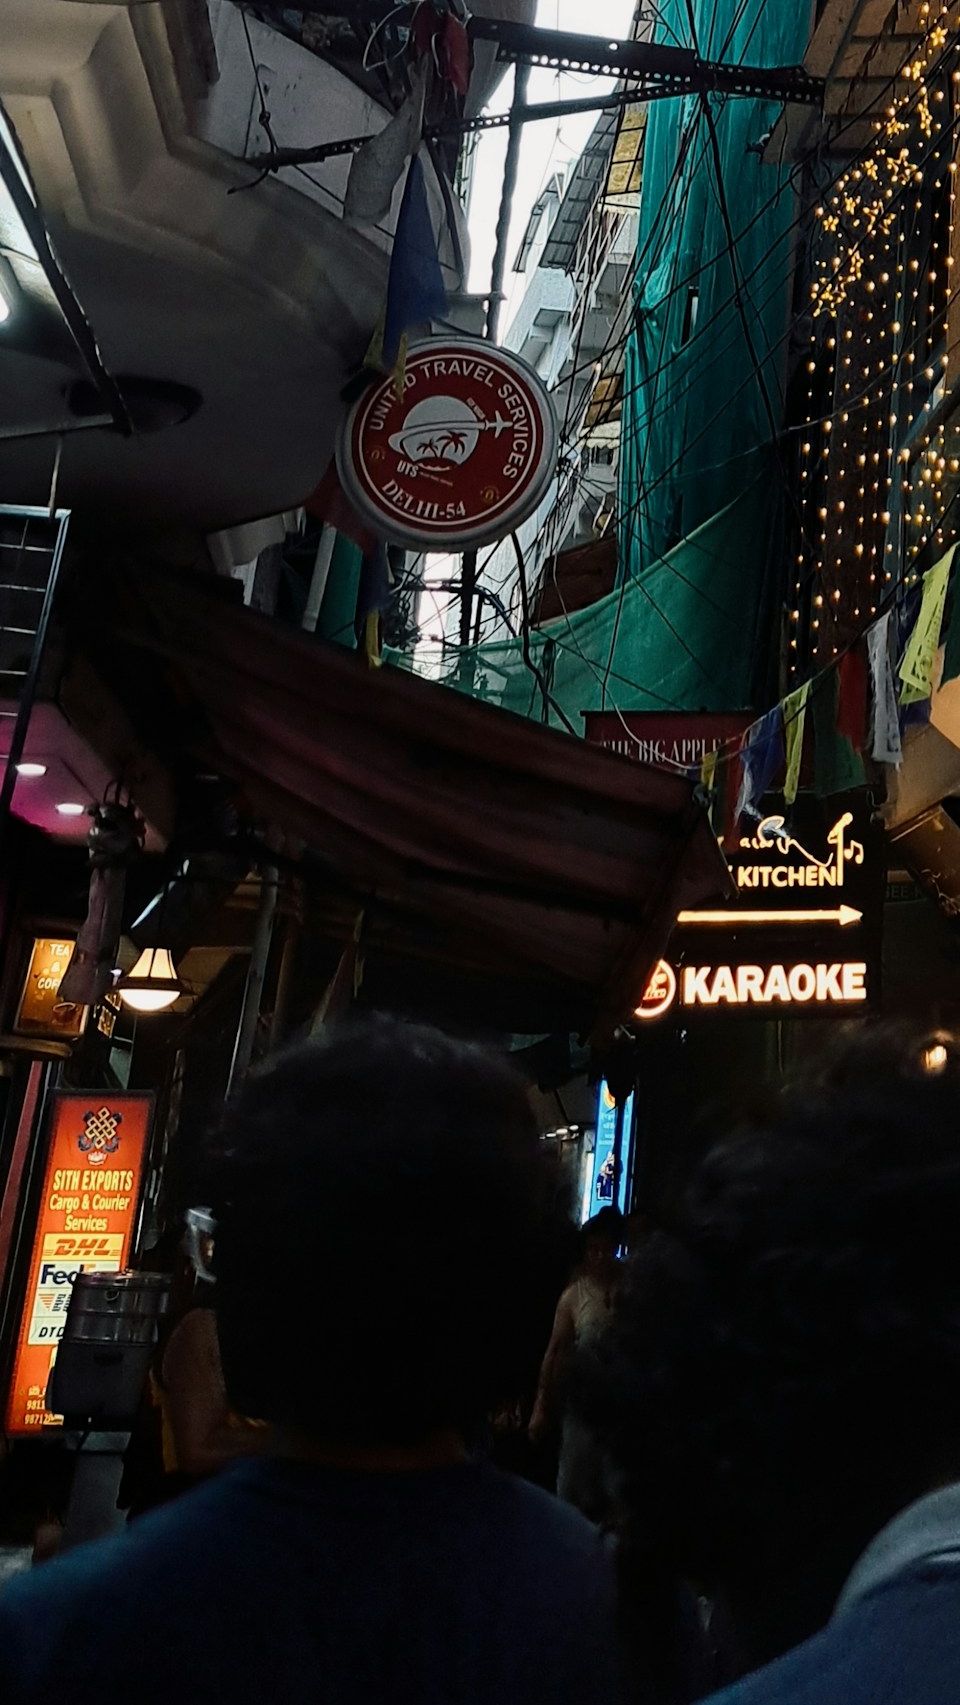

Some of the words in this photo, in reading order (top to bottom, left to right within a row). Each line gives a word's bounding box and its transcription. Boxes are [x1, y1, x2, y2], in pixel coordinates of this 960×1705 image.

[420, 360, 496, 388] TRAVEL
[497, 383, 529, 479] SERVICES
[396, 460, 420, 478] UTS
[381, 479, 467, 519] DELHI-54
[638, 738, 666, 763] BIG
[737, 865, 837, 888] KITCHEN
[49, 943, 71, 957] TEA
[683, 962, 867, 1005] KARAOKE
[53, 1169, 80, 1191] SITH
[81, 1170, 134, 1192] EXPORTS
[49, 1193, 80, 1214] Cargo
[81, 1193, 90, 1210] &
[92, 1193, 130, 1211] Courier
[64, 1214, 108, 1232] Services
[54, 1239, 110, 1256] DHL
